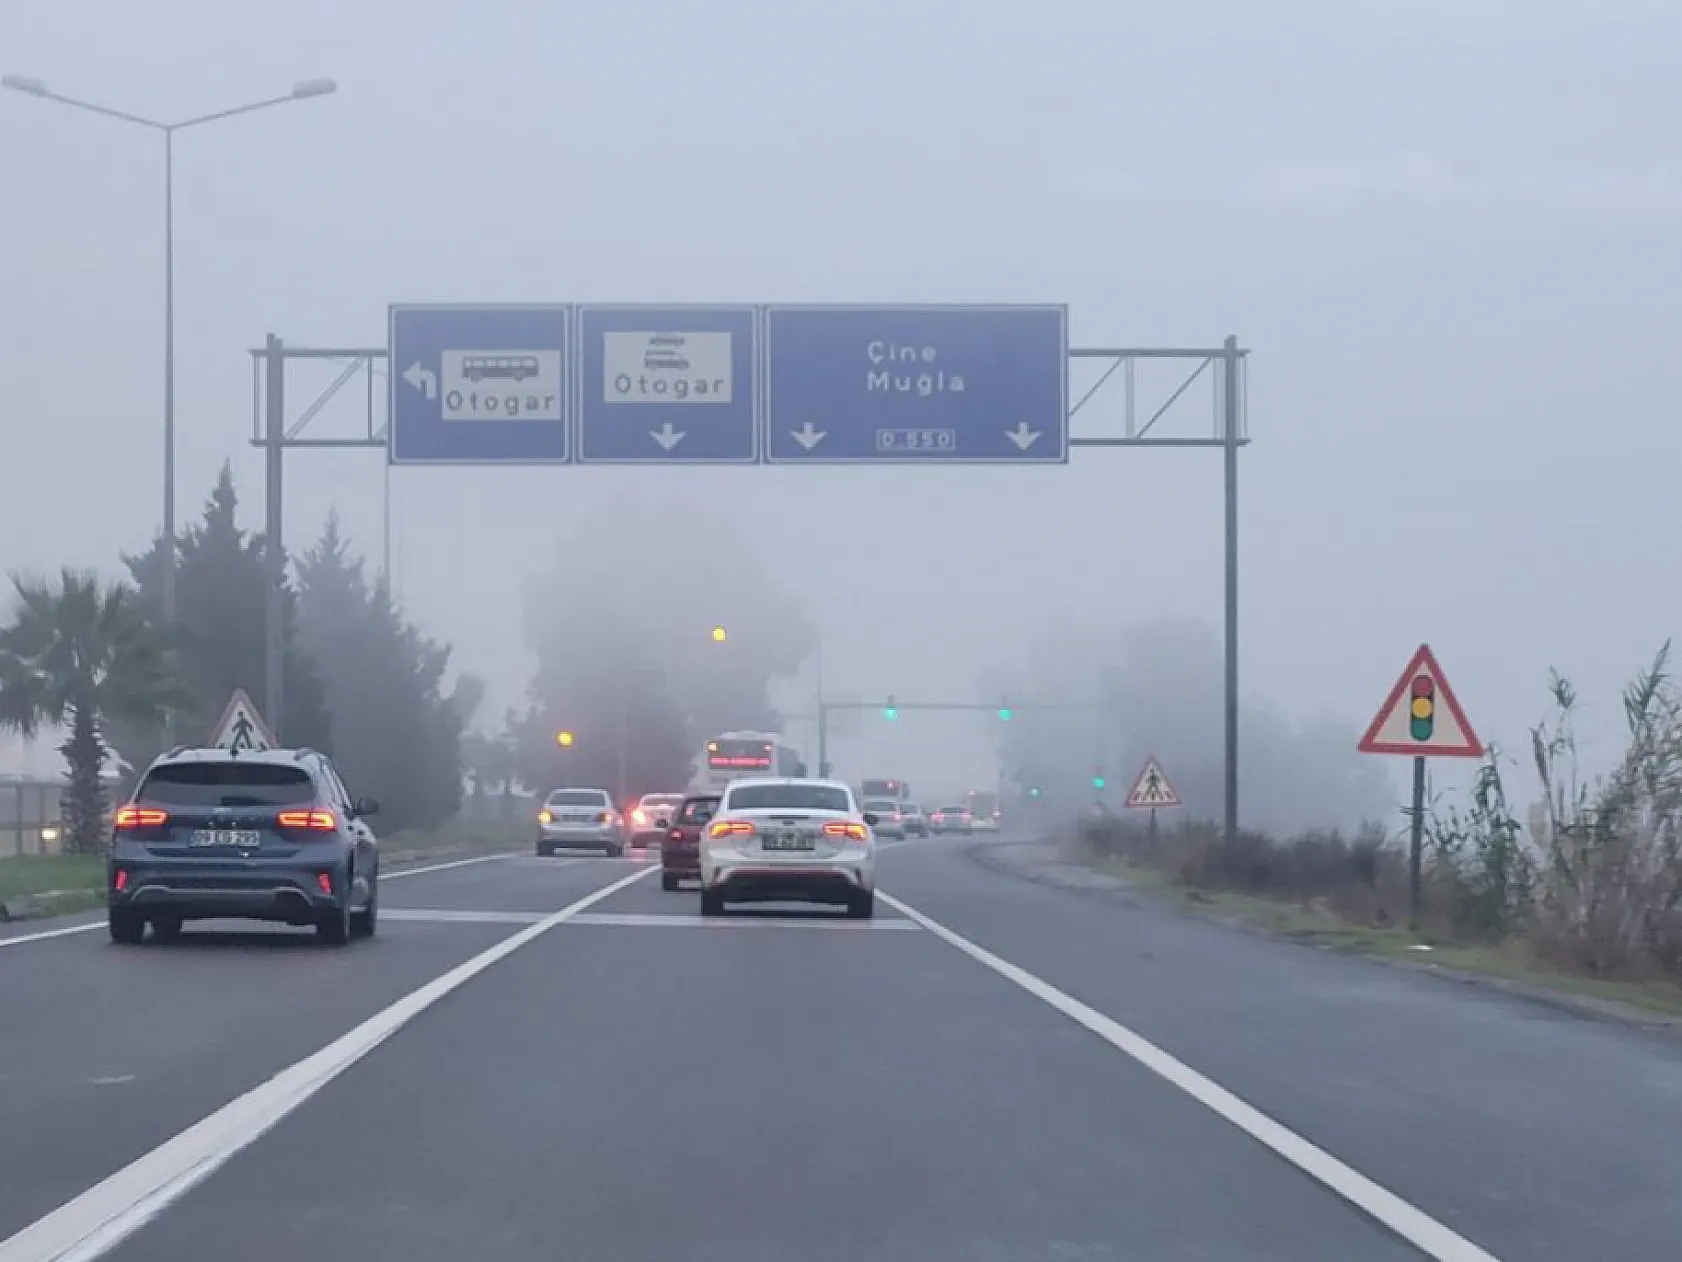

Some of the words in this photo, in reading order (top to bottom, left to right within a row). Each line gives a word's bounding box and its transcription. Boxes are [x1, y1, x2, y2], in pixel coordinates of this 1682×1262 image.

[866, 341, 937, 364] Çine
[614, 373, 724, 399] Otogar
[446, 390, 555, 415] Otogar
